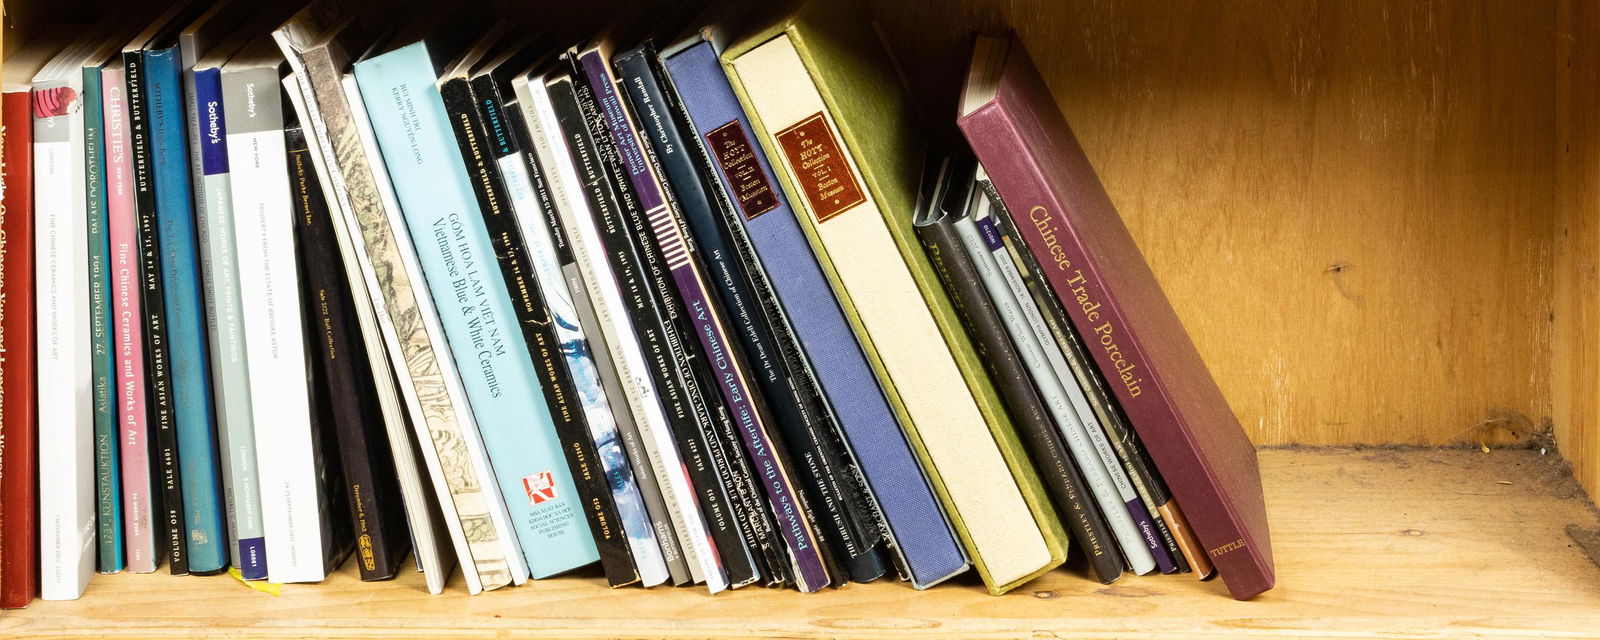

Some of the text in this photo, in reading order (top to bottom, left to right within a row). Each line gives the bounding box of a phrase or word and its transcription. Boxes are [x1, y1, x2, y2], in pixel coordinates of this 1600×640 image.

[129, 61, 140, 120] BUTTERFIELD
[245, 83, 257, 117] Sotheby's
[109, 86, 123, 163] CHRISTIE'S
[204, 100, 221, 144] Sotheby's
[459, 111, 481, 160] BUTTERFIELD
[482, 98, 509, 146] BUTTERFIELD
[598, 72, 647, 173] University of Hawaii Press
[601, 96, 639, 175] Denver Art Museum
[633, 75, 675, 154] By Christopher Randall
[135, 133, 146, 191] BUTTERFIELD
[293, 153, 304, 176] Sotheby
[525, 151, 540, 177] Francisco
[572, 132, 597, 179] BUTTERFIELD
[800, 143, 822, 160] HOYT
[802, 153, 830, 169] Collection
[298, 176, 308, 194] Parke
[301, 194, 311, 213] Bernet
[478, 166, 500, 215] BUTTERFIELD
[534, 177, 544, 189] San
[538, 188, 548, 202] 2011
[818, 178, 838, 191] Boston
[820, 185, 844, 200] Museum
[545, 208, 558, 227] March
[593, 186, 617, 234] BUTTERFIELD
[552, 225, 567, 248] Tuesday
[964, 233, 995, 278] Summer 2010
[147, 272, 155, 289] MAY
[456, 242, 476, 269] HOA
[466, 269, 485, 298] LAM
[486, 326, 507, 357] NAM
[1030, 205, 1143, 399] Chinese Trade Porcelain
[428, 217, 506, 399] Vietnamese Blue & White Ceramics
[712, 248, 777, 382] The Dr Dean Edell Collection of Chinese Art
[118, 243, 137, 445] Fine Chinese Ceramics and Works of Art
[1000, 301, 1042, 370] Chinese White Wares
[151, 313, 168, 429] FINE ASIAN WORKS OF ART
[534, 331, 571, 422] FINE ASIAN WORKS OF ART
[645, 327, 685, 419] FINE ASIAN WORKS OF ART
[662, 319, 687, 367] EXHIBITION
[680, 366, 692, 380] OF
[694, 402, 710, 428] MARK
[704, 428, 718, 449] AND
[712, 448, 730, 480] PERIOD
[724, 479, 738, 501] BLUE
[733, 501, 746, 521] AND
[741, 521, 757, 550] WHITE
[690, 299, 809, 551] Pathways to the Afterlife: Early Chinese Art
[716, 405, 727, 421] Kong
[721, 419, 733, 435] Hong
[624, 430, 647, 480] Asian Works of Art
[730, 439, 742, 458] Society
[1086, 420, 1127, 489] CHINESE WORKS OF ART
[753, 497, 761, 507] the
[756, 505, 763, 513] of
[759, 512, 771, 532] Bulletin
[804, 450, 858, 559] THE BRUSH AND THE STONE
[653, 520, 675, 562] Bonhams
[1138, 518, 1159, 549] Sotheby's
[1210, 537, 1246, 558] TUTTLE
